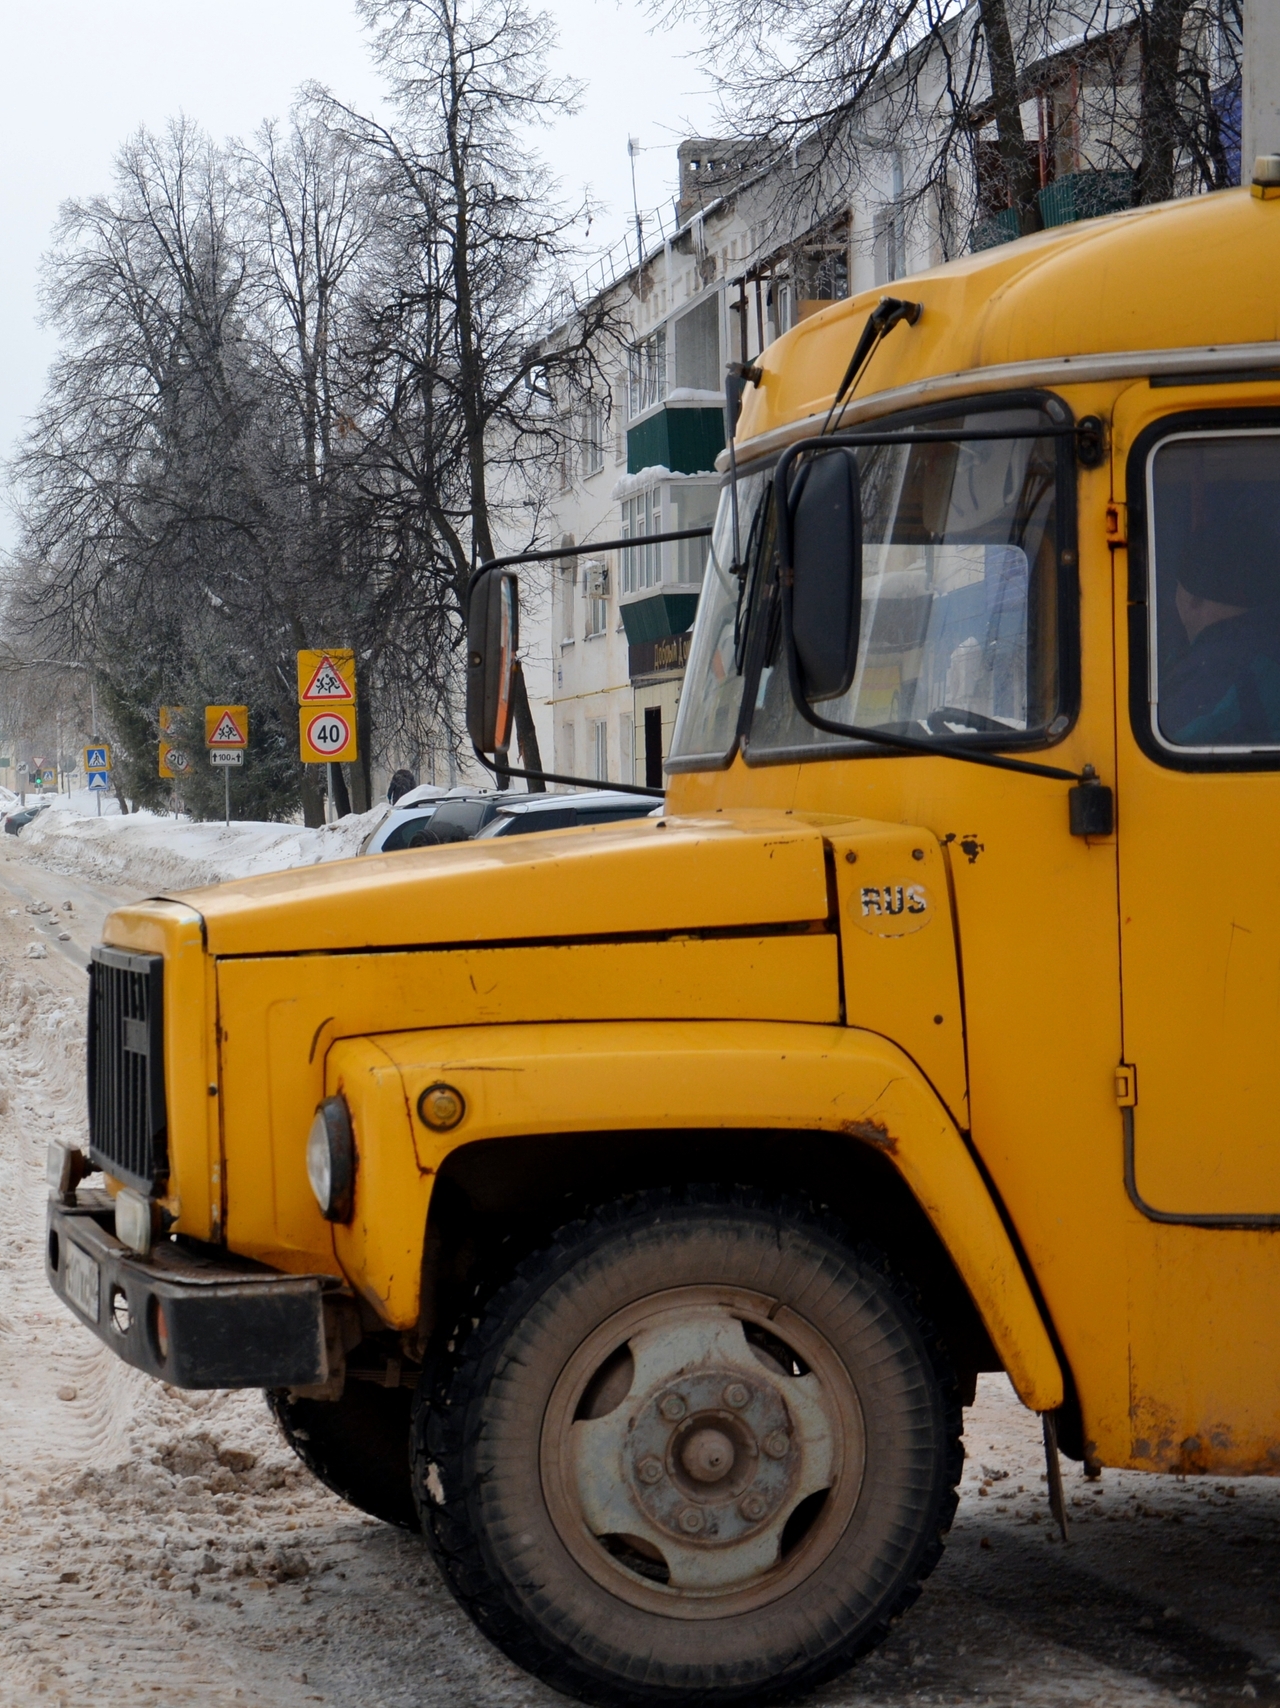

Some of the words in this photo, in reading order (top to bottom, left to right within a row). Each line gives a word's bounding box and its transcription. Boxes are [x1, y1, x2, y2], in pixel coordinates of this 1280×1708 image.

[317, 724, 340, 744] 40
[170, 754, 184, 766] 20
[218, 753, 231, 761] 100
[860, 885, 927, 916] RUS
